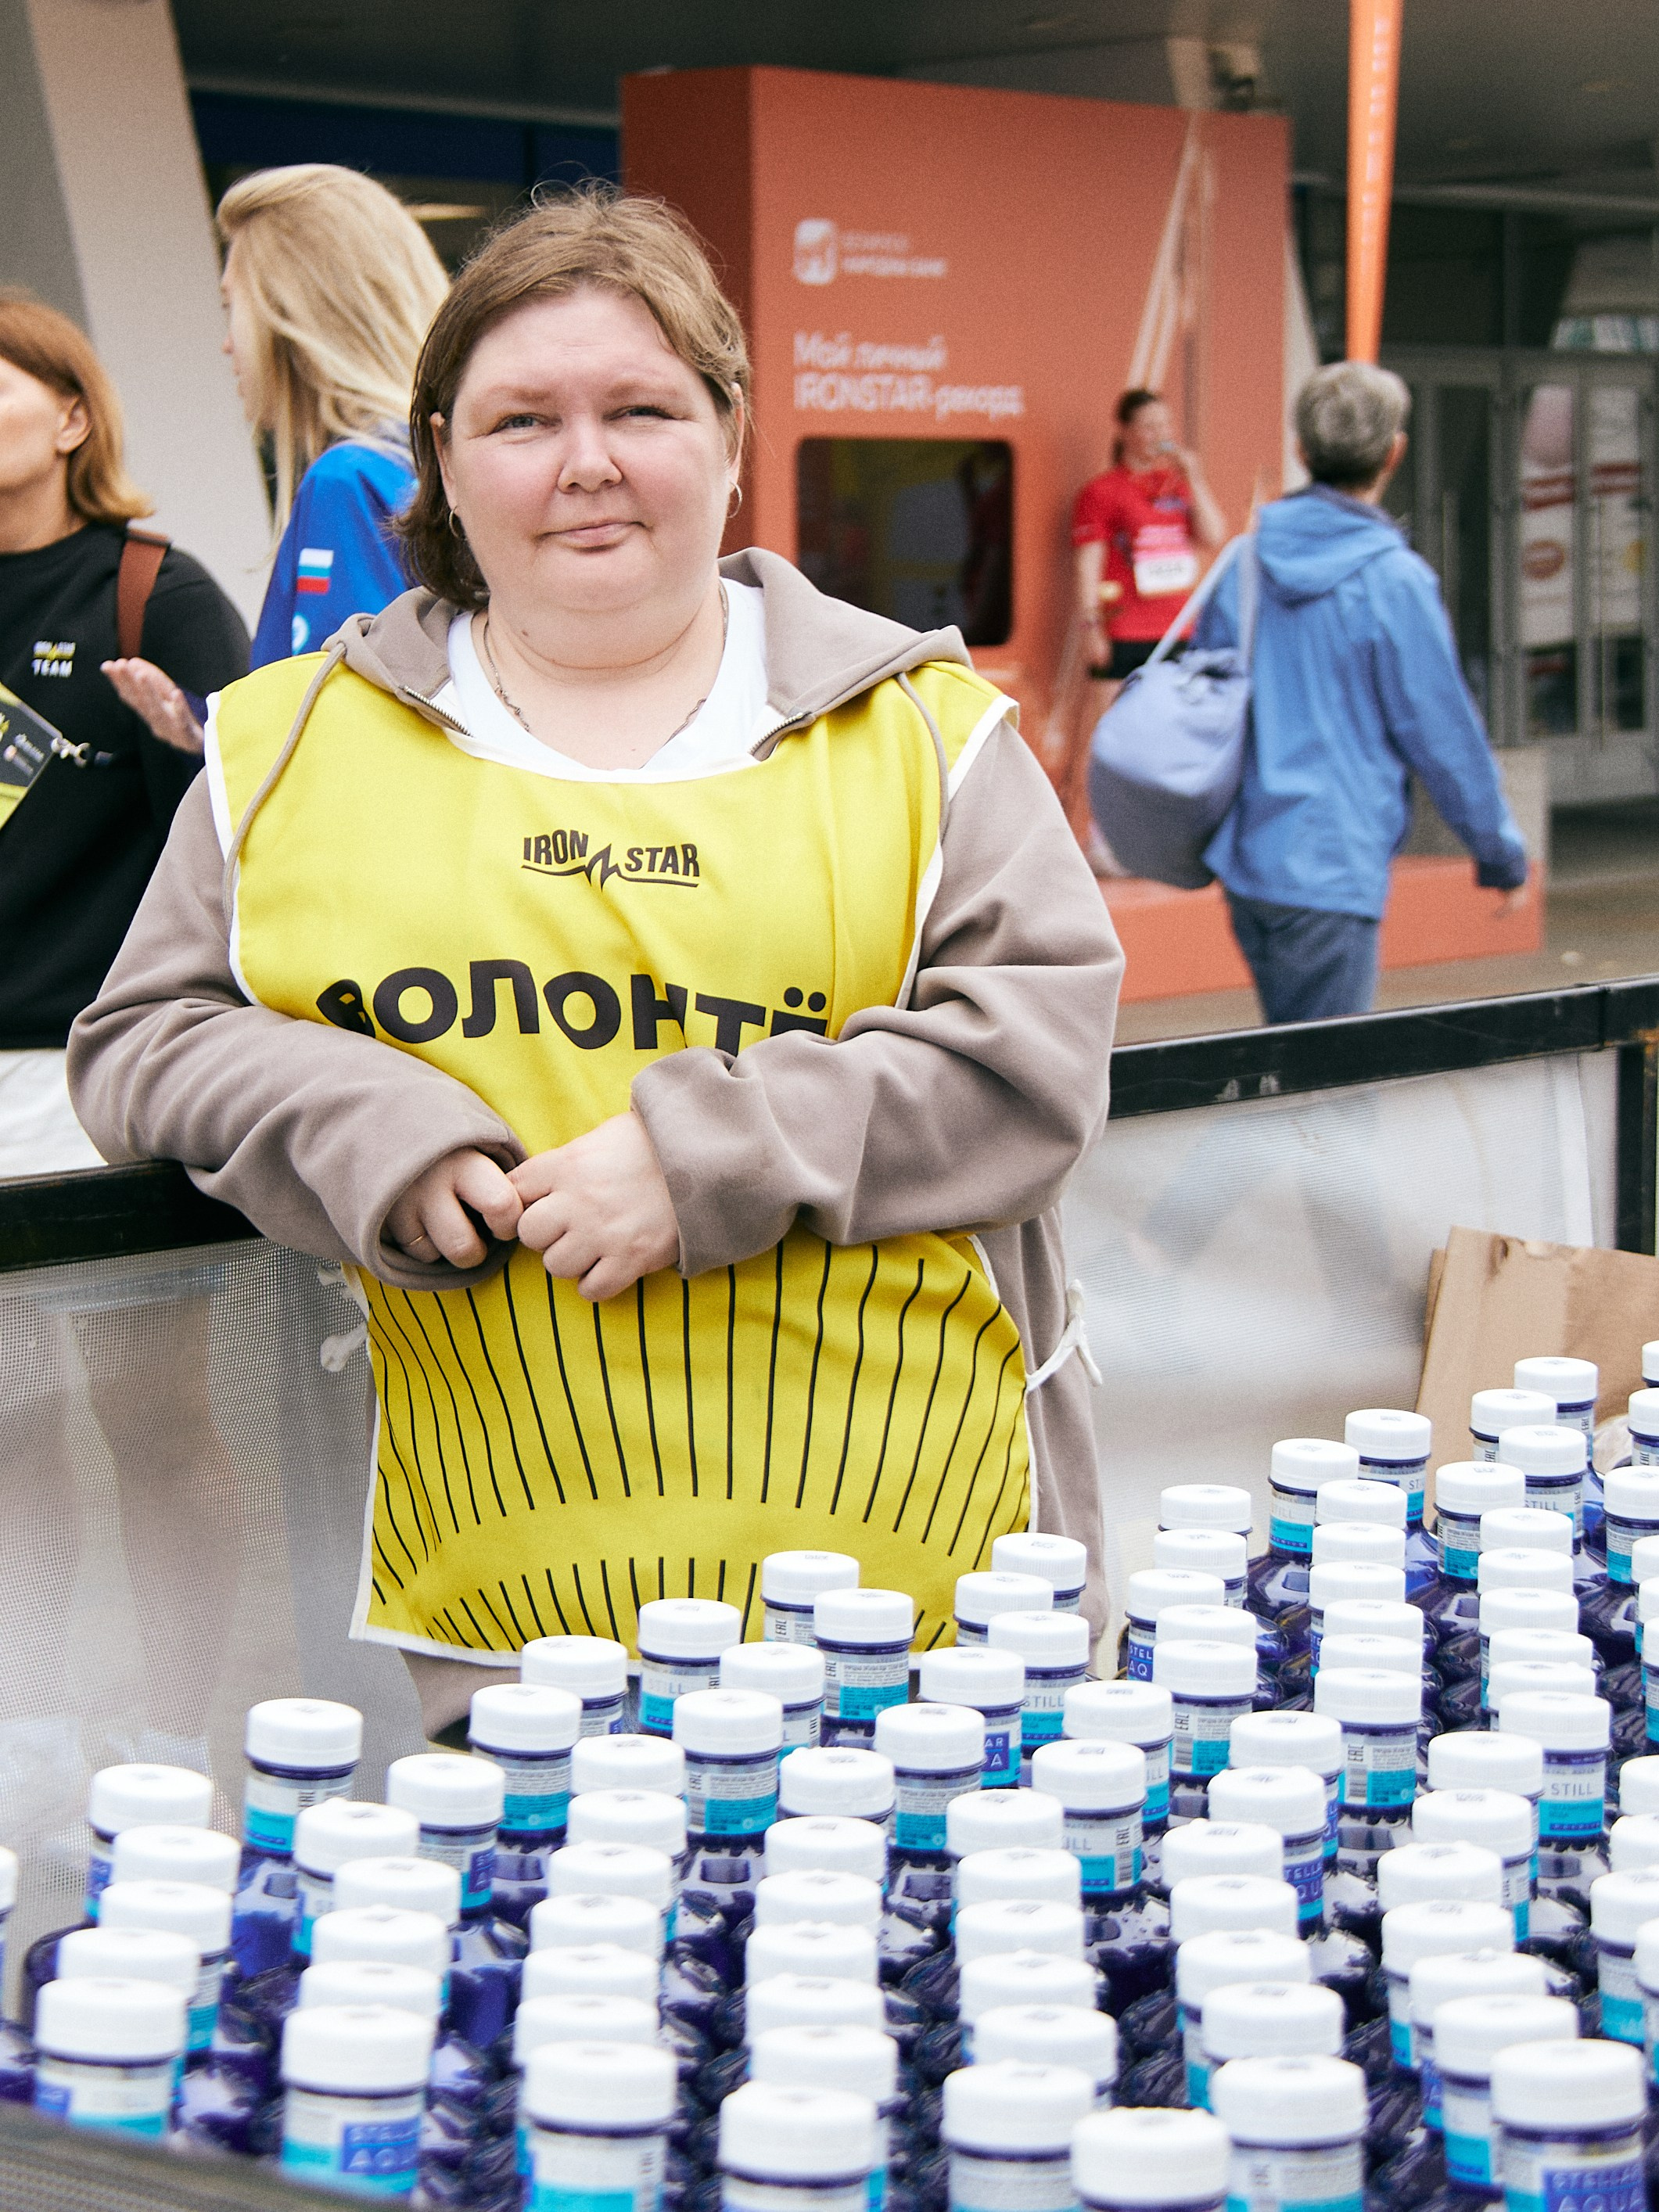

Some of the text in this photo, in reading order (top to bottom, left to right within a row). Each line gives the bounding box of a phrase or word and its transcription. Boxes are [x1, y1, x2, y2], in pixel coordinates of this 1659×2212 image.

[31, 659, 73, 677] TEAM
[522, 828, 700, 878] IRON STAR
[1551, 1783, 1593, 1796] STILL
